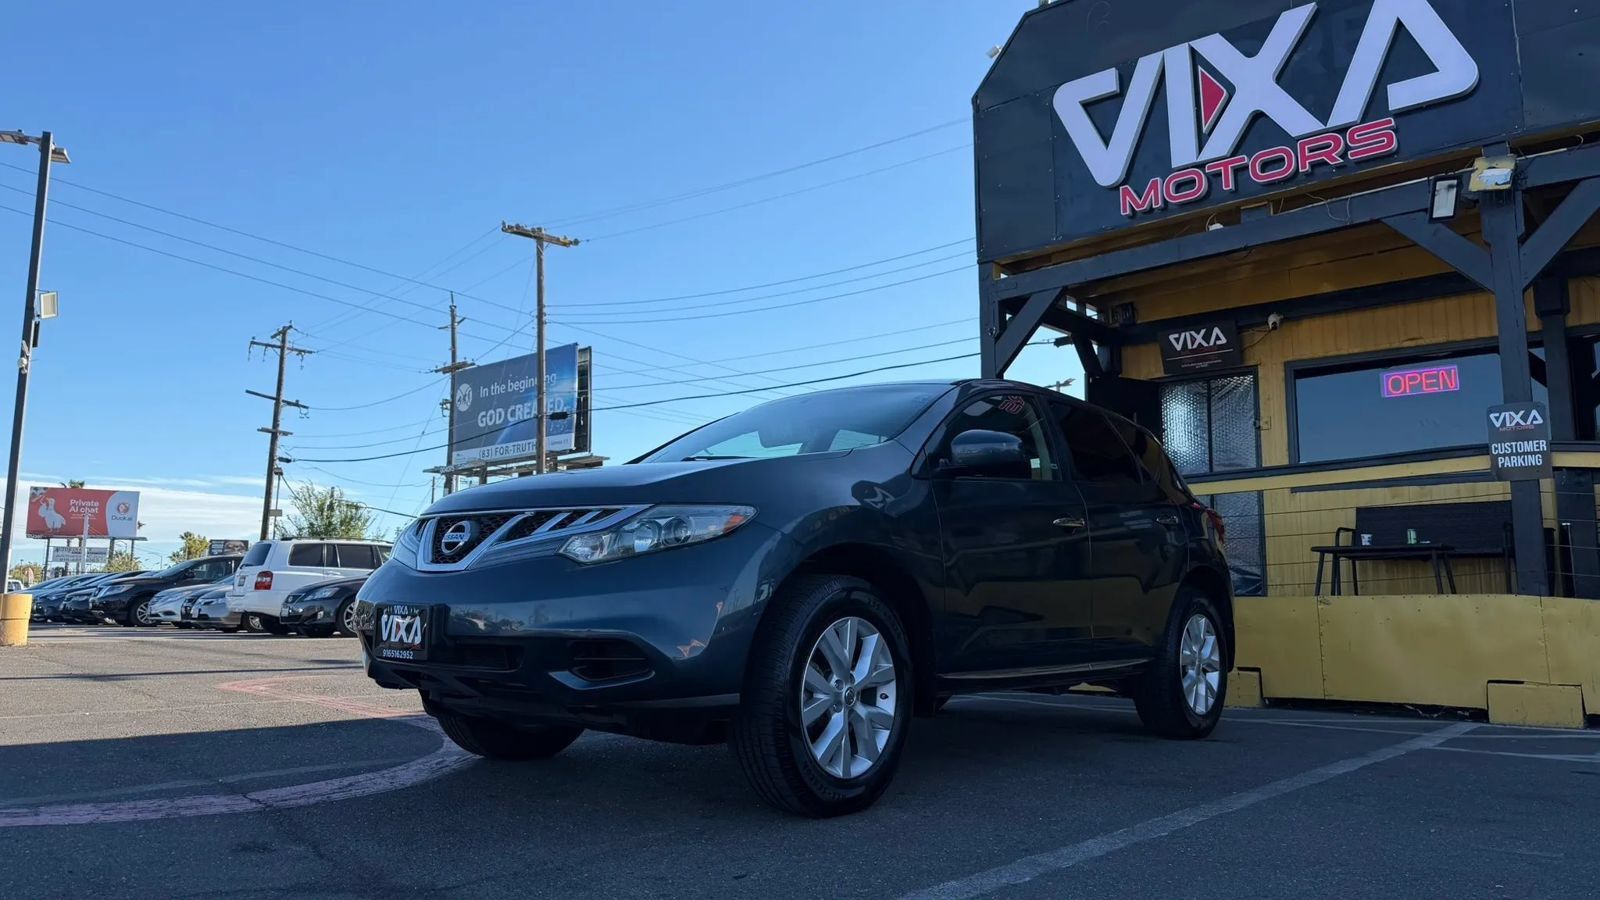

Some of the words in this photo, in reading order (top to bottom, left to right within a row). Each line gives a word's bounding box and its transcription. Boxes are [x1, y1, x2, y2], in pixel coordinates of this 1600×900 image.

[1053, 0, 1479, 188] VIXA
[1120, 117, 1397, 216] MOTORS
[1168, 326, 1228, 351] VIXA
[480, 386, 489, 398] In
[490, 381, 506, 396] the
[508, 373, 557, 392] beginng
[1387, 368, 1456, 394] OPEN
[478, 407, 505, 427] GOD
[1489, 409, 1544, 428] VIXA
[1491, 439, 1547, 455] CUSTOMER
[1498, 454, 1543, 468] PARKING
[69, 499, 99, 507] Private
[393, 605, 409, 615] VIXA
[381, 614, 422, 645] VIXA
